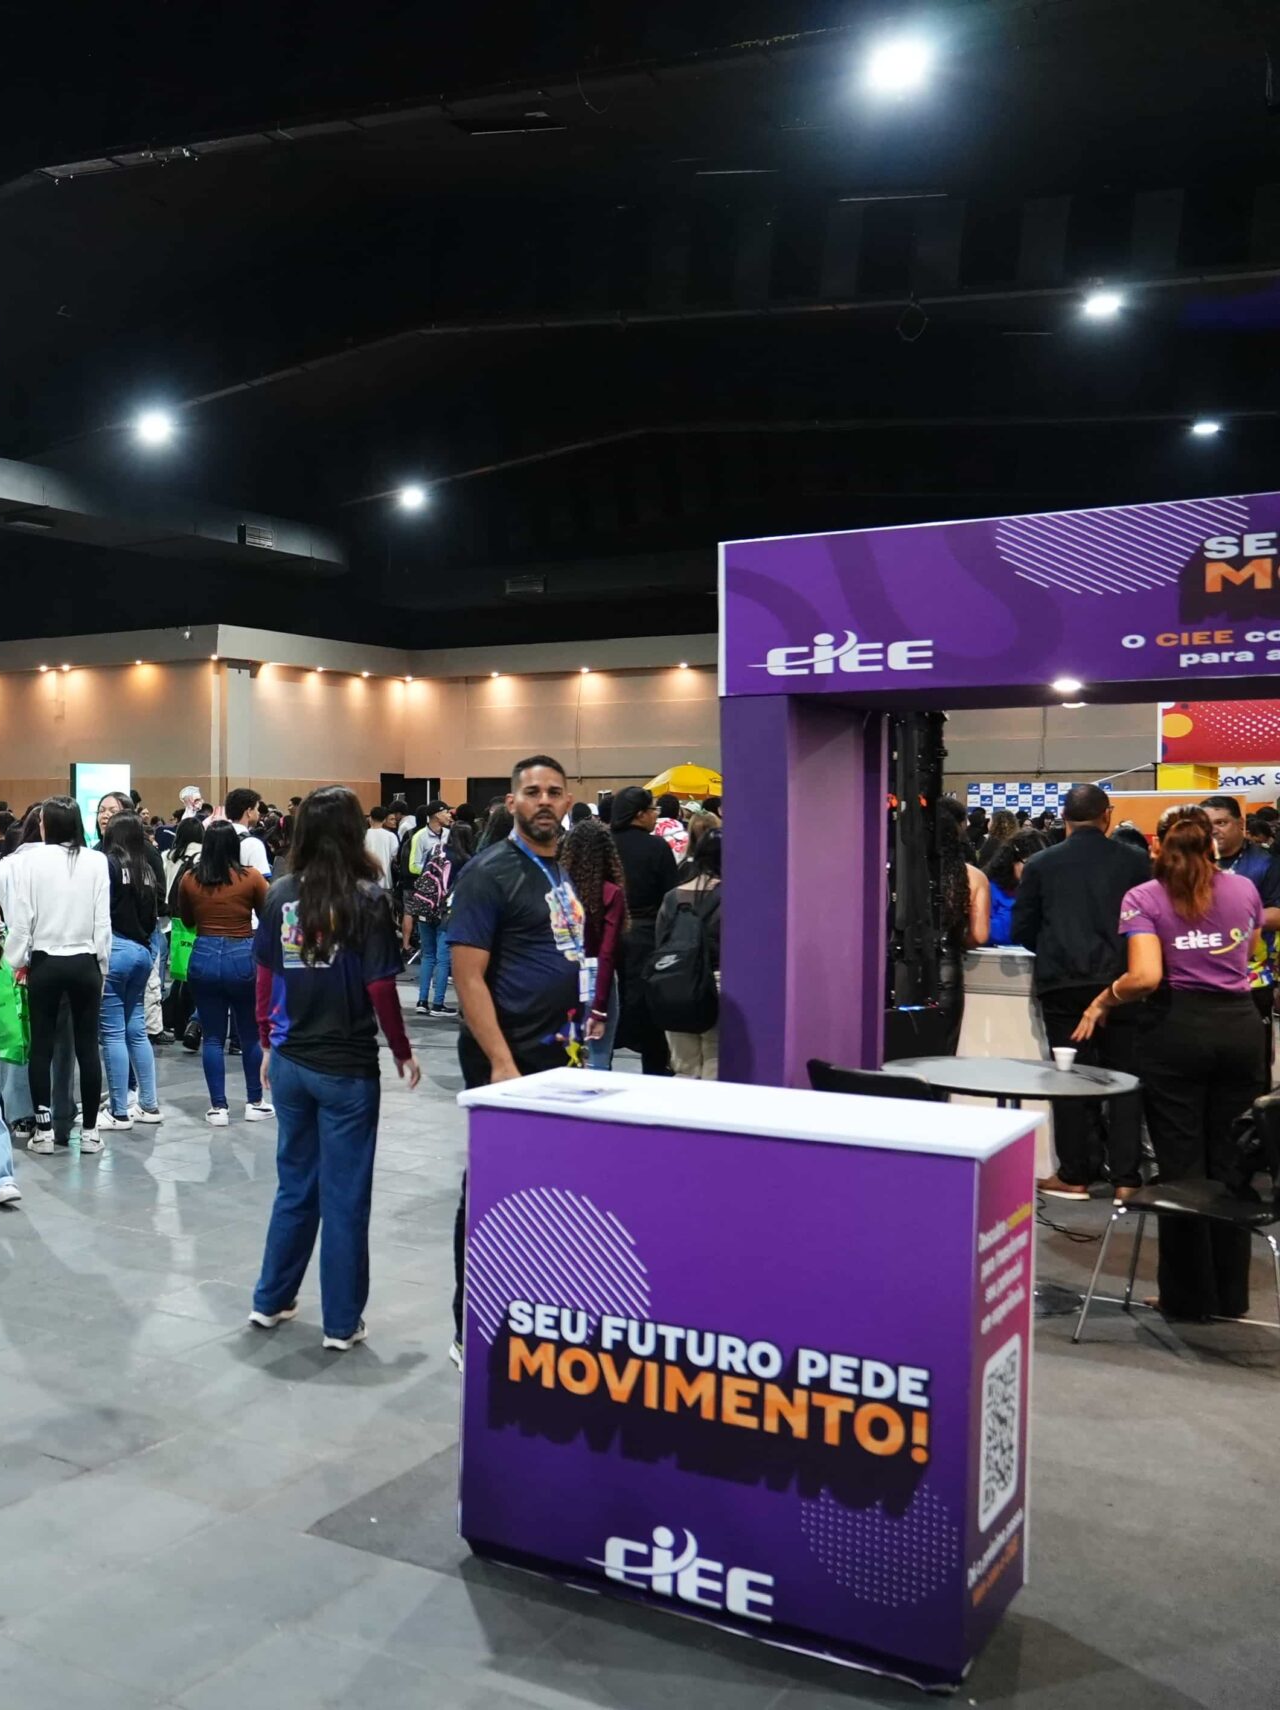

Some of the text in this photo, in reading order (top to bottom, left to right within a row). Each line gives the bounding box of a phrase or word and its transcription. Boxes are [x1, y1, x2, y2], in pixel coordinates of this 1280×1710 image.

[1155, 629, 1234, 647] CIEE
[1179, 651, 1255, 668] para
[508, 1301, 930, 1408] SEU FUTURO PEDE
[508, 1336, 929, 1465] MOVIMENTO!
